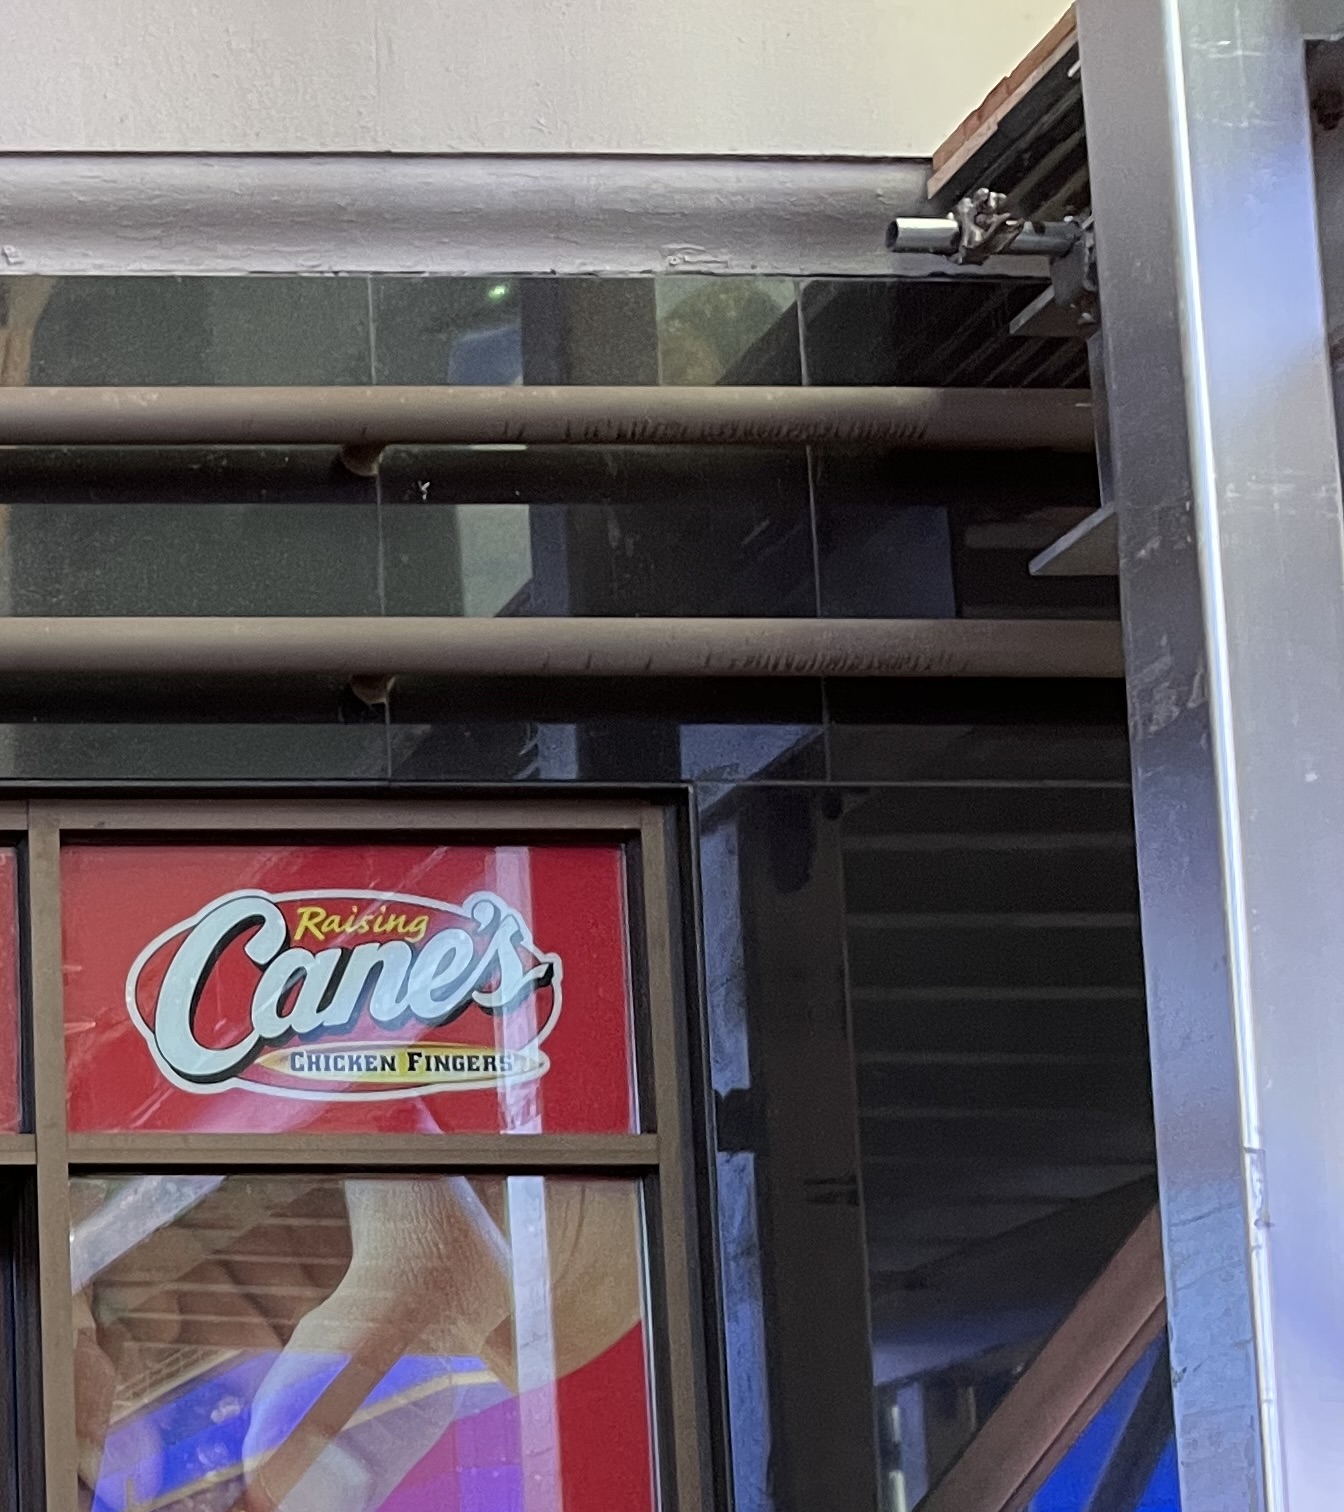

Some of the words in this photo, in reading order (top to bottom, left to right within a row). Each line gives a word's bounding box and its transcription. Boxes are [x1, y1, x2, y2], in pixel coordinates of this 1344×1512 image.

[294, 907, 429, 942] Raising
[155, 896, 553, 1076] Cane's
[290, 1049, 396, 1073] CHICKEN
[408, 1049, 513, 1073] FINGERS
